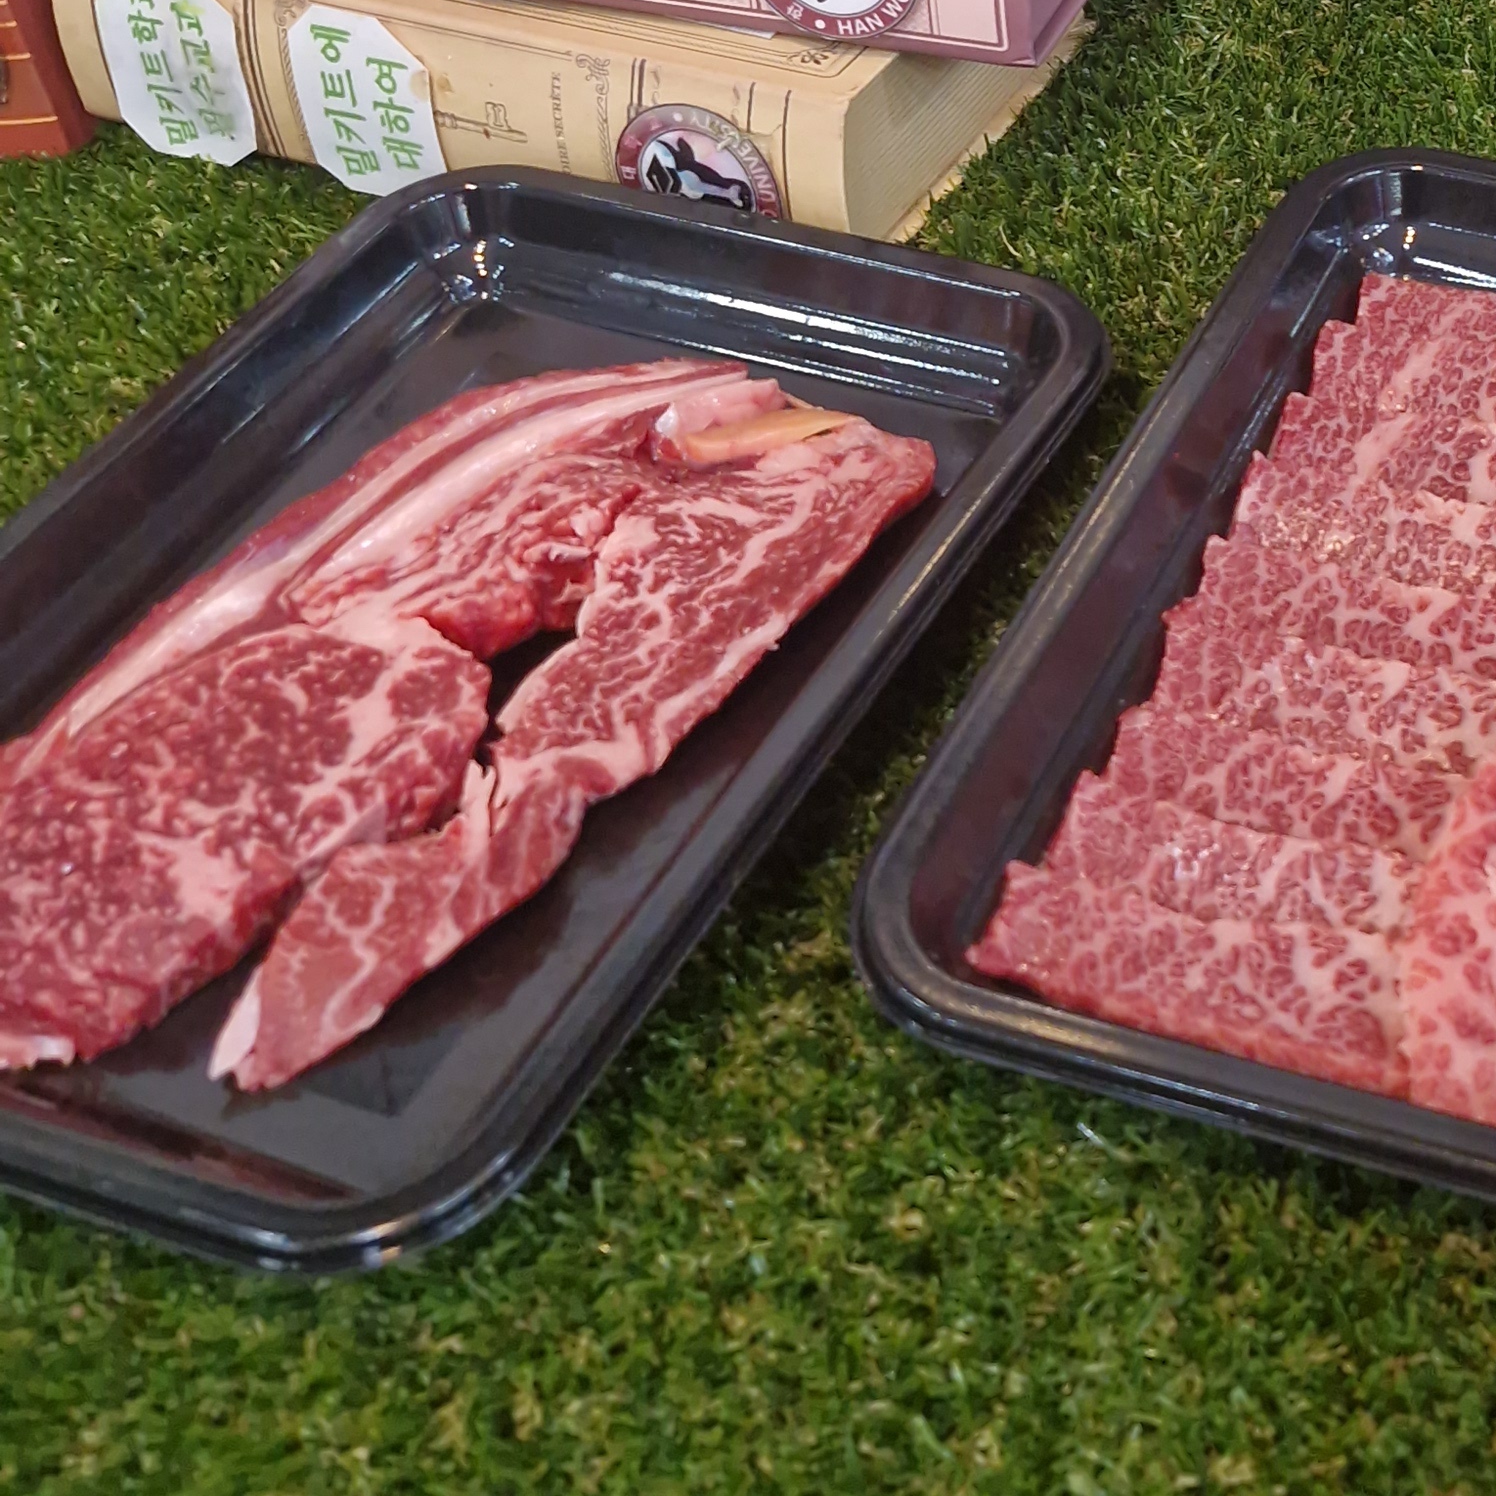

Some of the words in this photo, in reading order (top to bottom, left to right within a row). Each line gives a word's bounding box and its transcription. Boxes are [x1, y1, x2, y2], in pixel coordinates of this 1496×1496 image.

[836, 12, 885, 36] HAN
[309, 23, 382, 176] 밀키트에
[365, 56, 425, 170] 대하여
